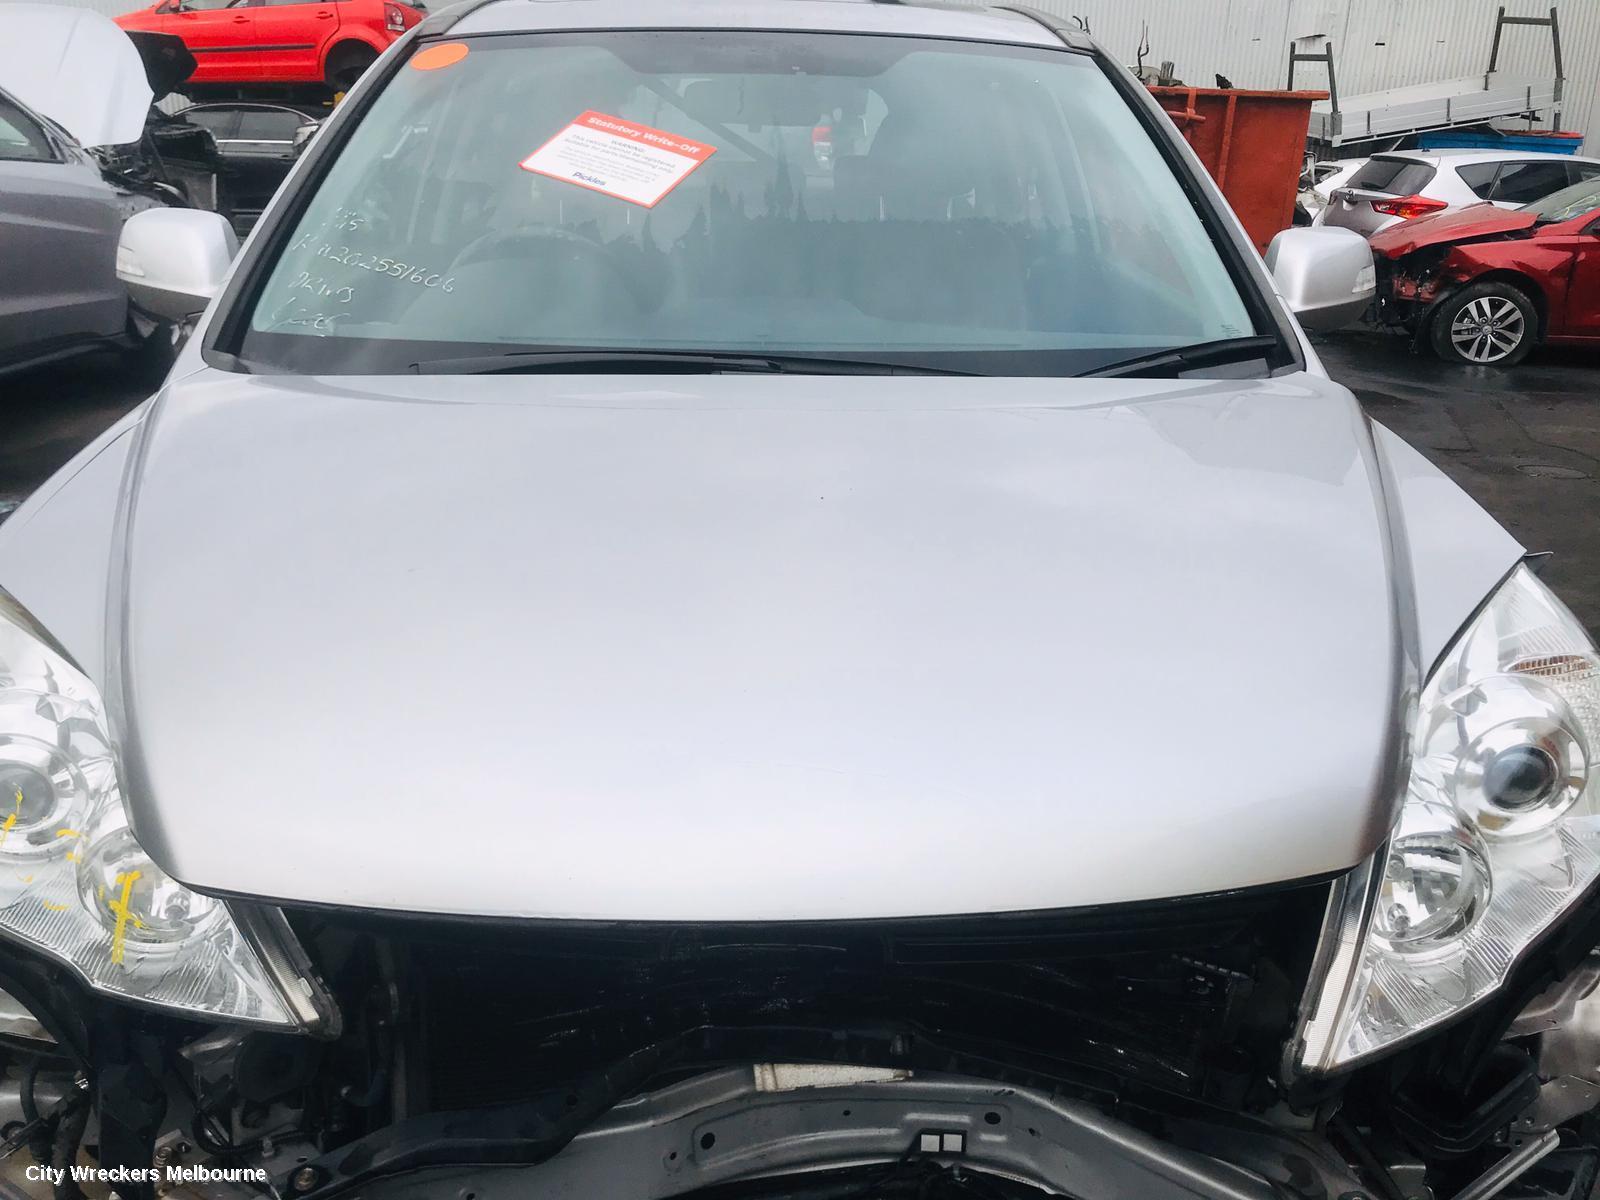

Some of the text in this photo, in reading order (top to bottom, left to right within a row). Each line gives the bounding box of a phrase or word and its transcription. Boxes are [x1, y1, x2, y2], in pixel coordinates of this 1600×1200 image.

[587, 116, 701, 154] Statutory Write-Off
[572, 171, 607, 186] Pickles
